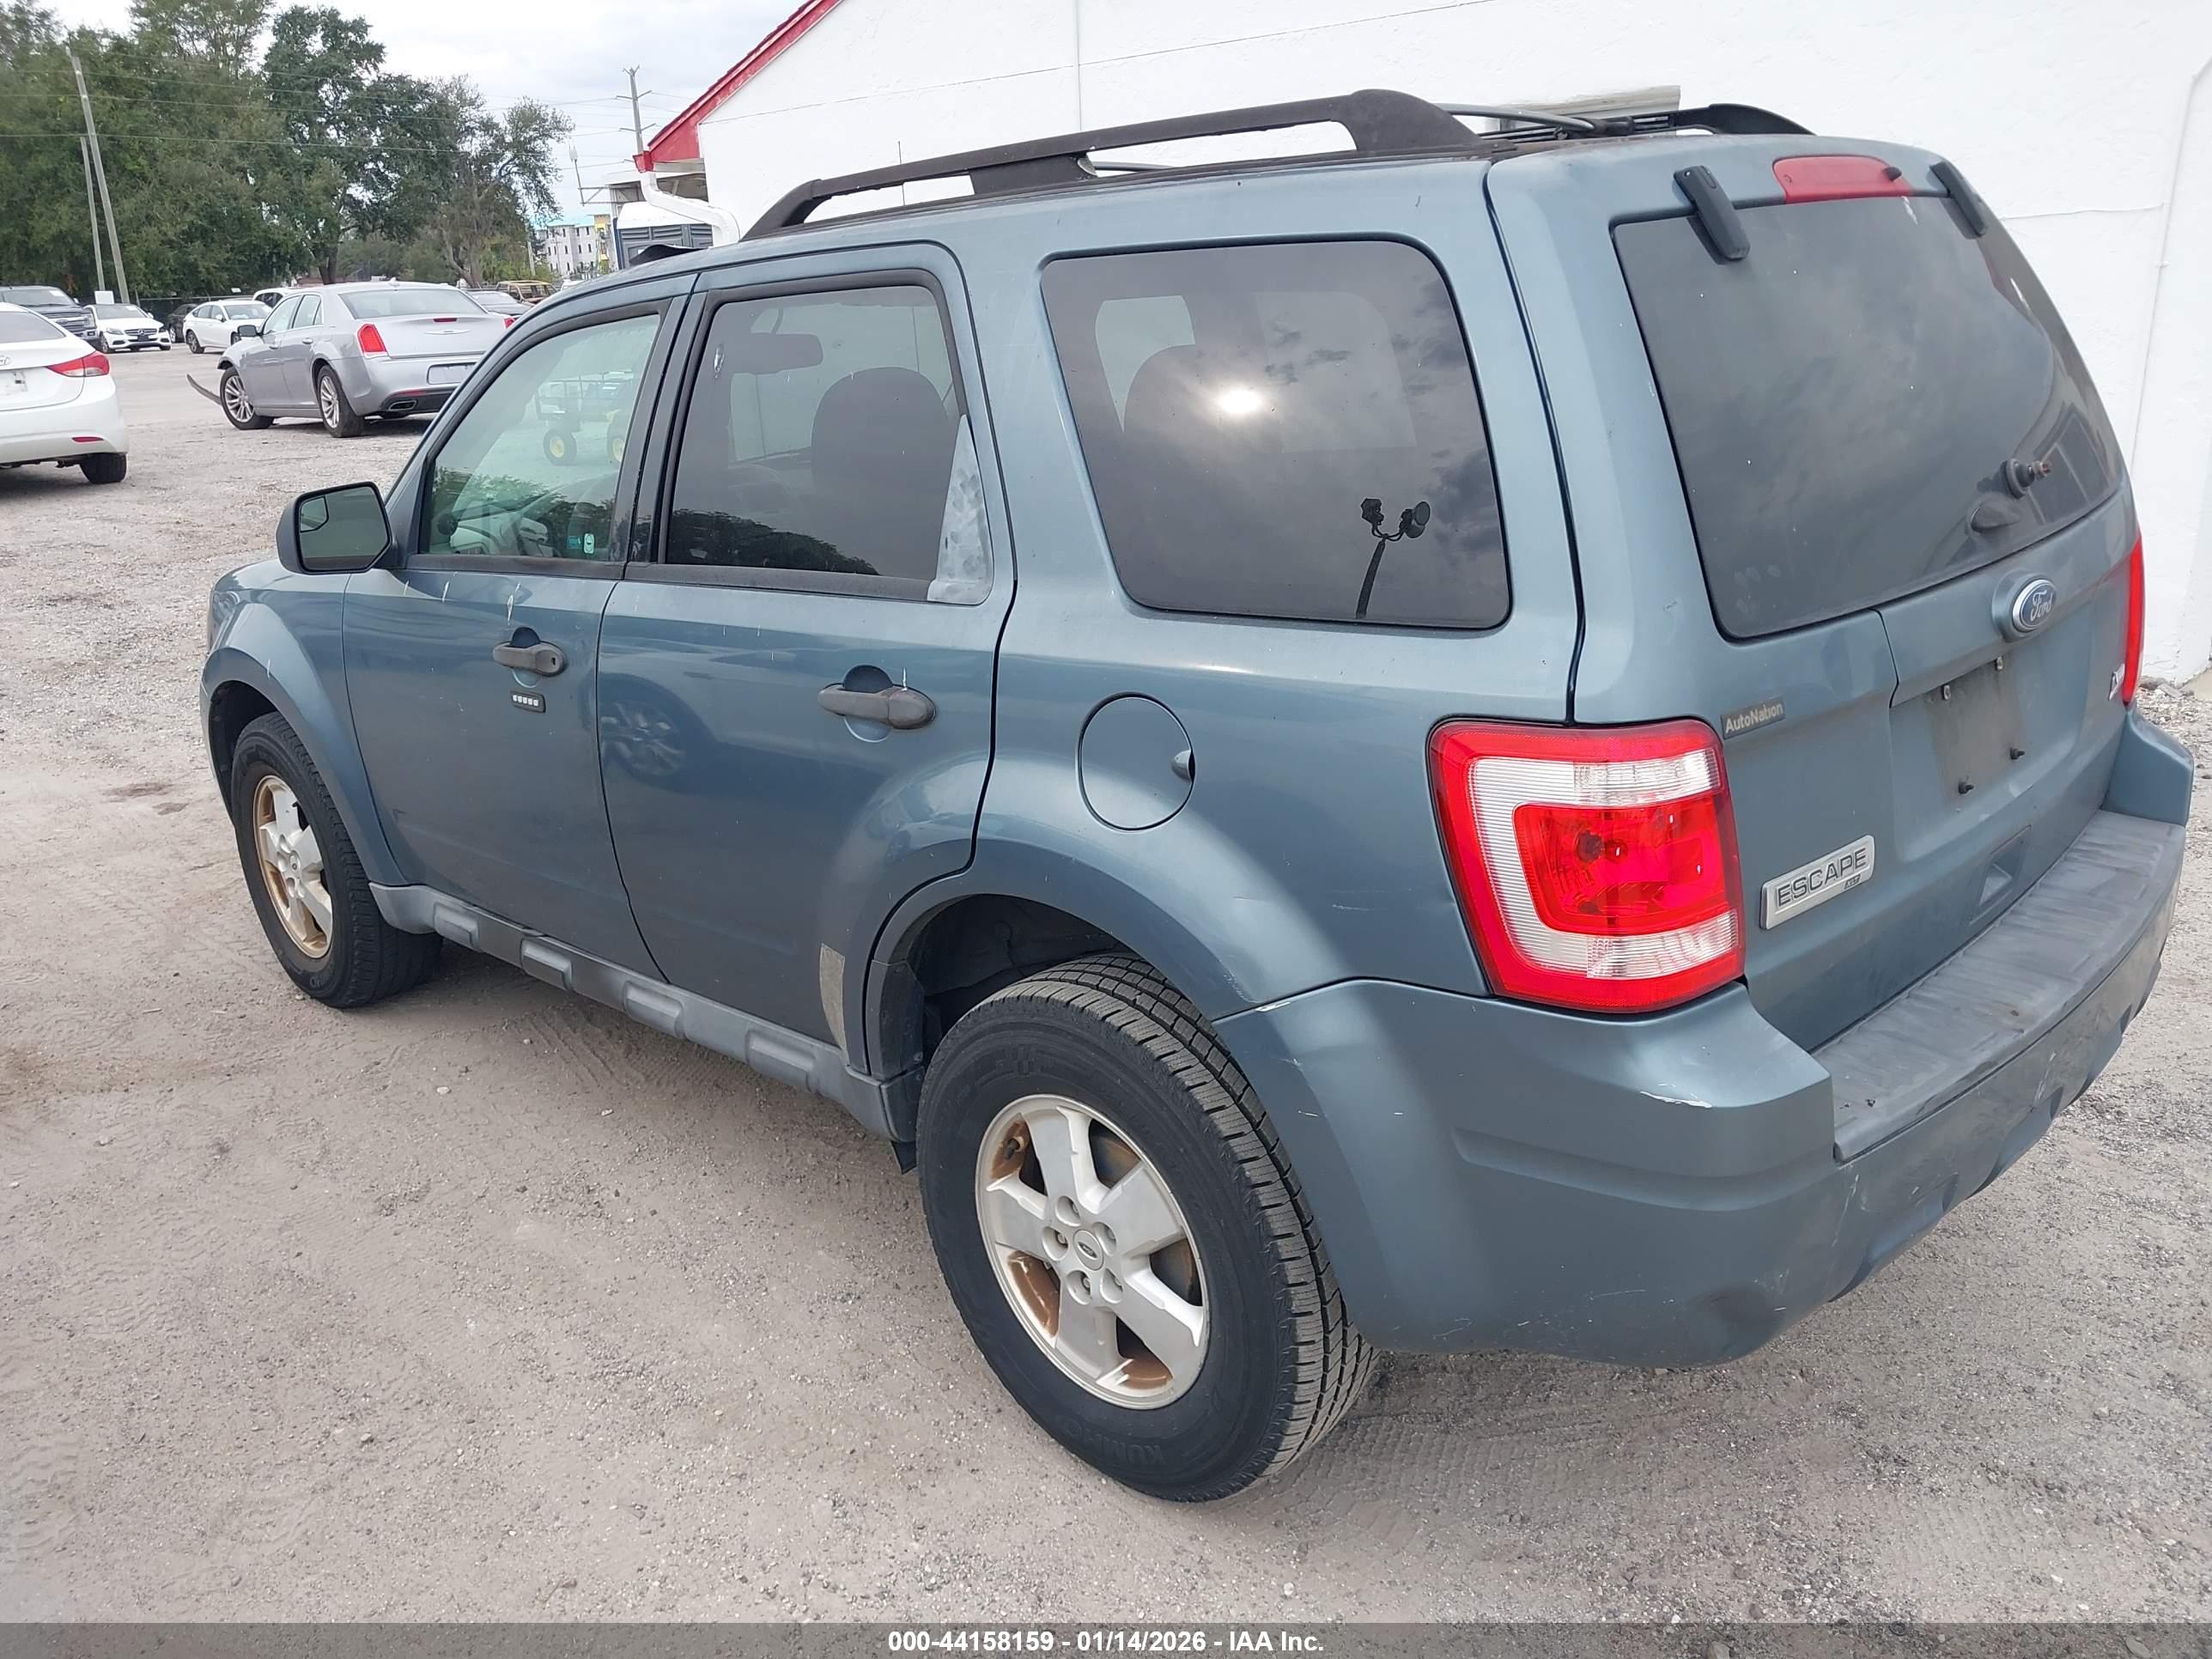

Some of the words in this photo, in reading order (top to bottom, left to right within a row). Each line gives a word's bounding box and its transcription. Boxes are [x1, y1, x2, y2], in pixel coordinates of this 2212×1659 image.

[2030, 589, 2053, 622] Ford
[1725, 703, 1784, 733] AutoNation
[1777, 847, 1867, 908] ESCAPE
